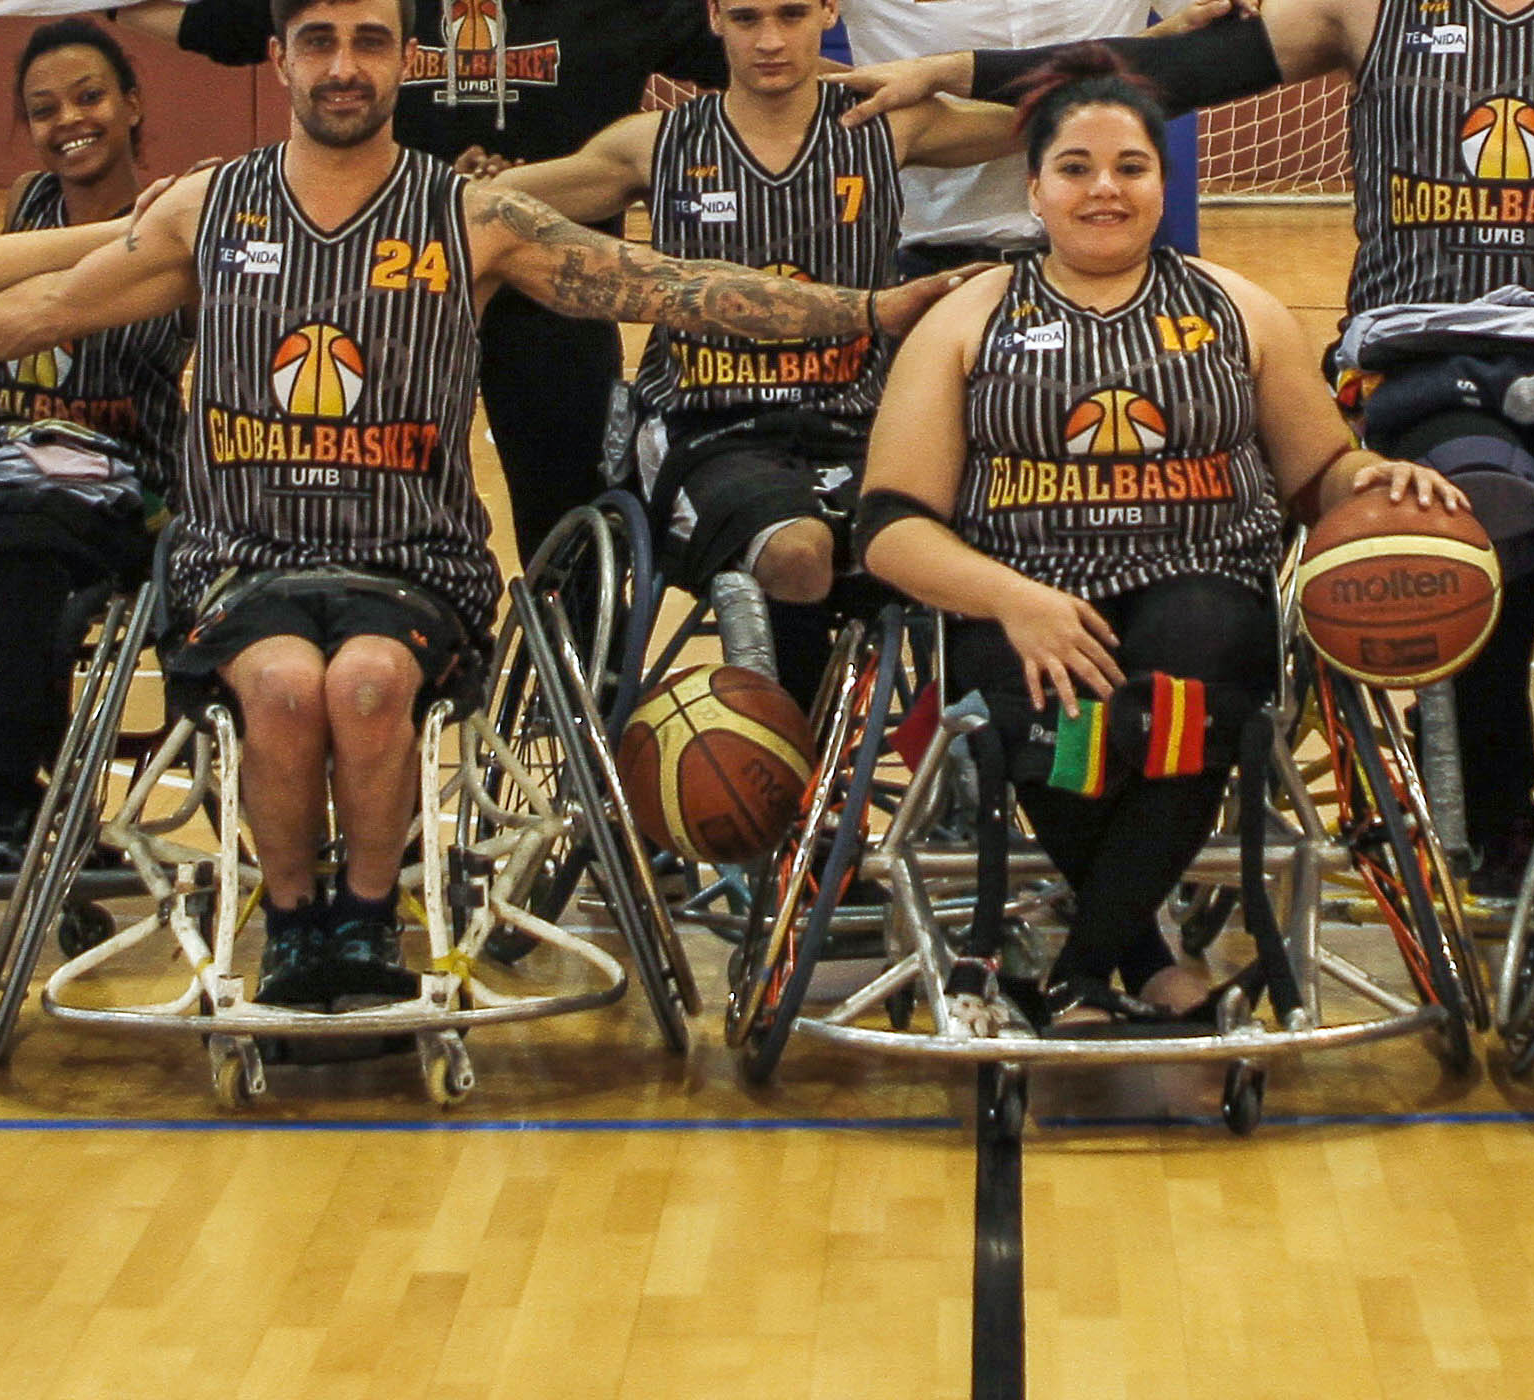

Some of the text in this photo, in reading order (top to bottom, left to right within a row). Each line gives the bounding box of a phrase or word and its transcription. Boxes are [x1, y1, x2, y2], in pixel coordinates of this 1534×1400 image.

[836, 175, 865, 223] 7
[370, 239, 450, 293] 24
[208, 406, 437, 473] GLOBALBASKET
[987, 452, 1234, 509] GLOBALBASKET
[1331, 567, 1460, 605] molten
